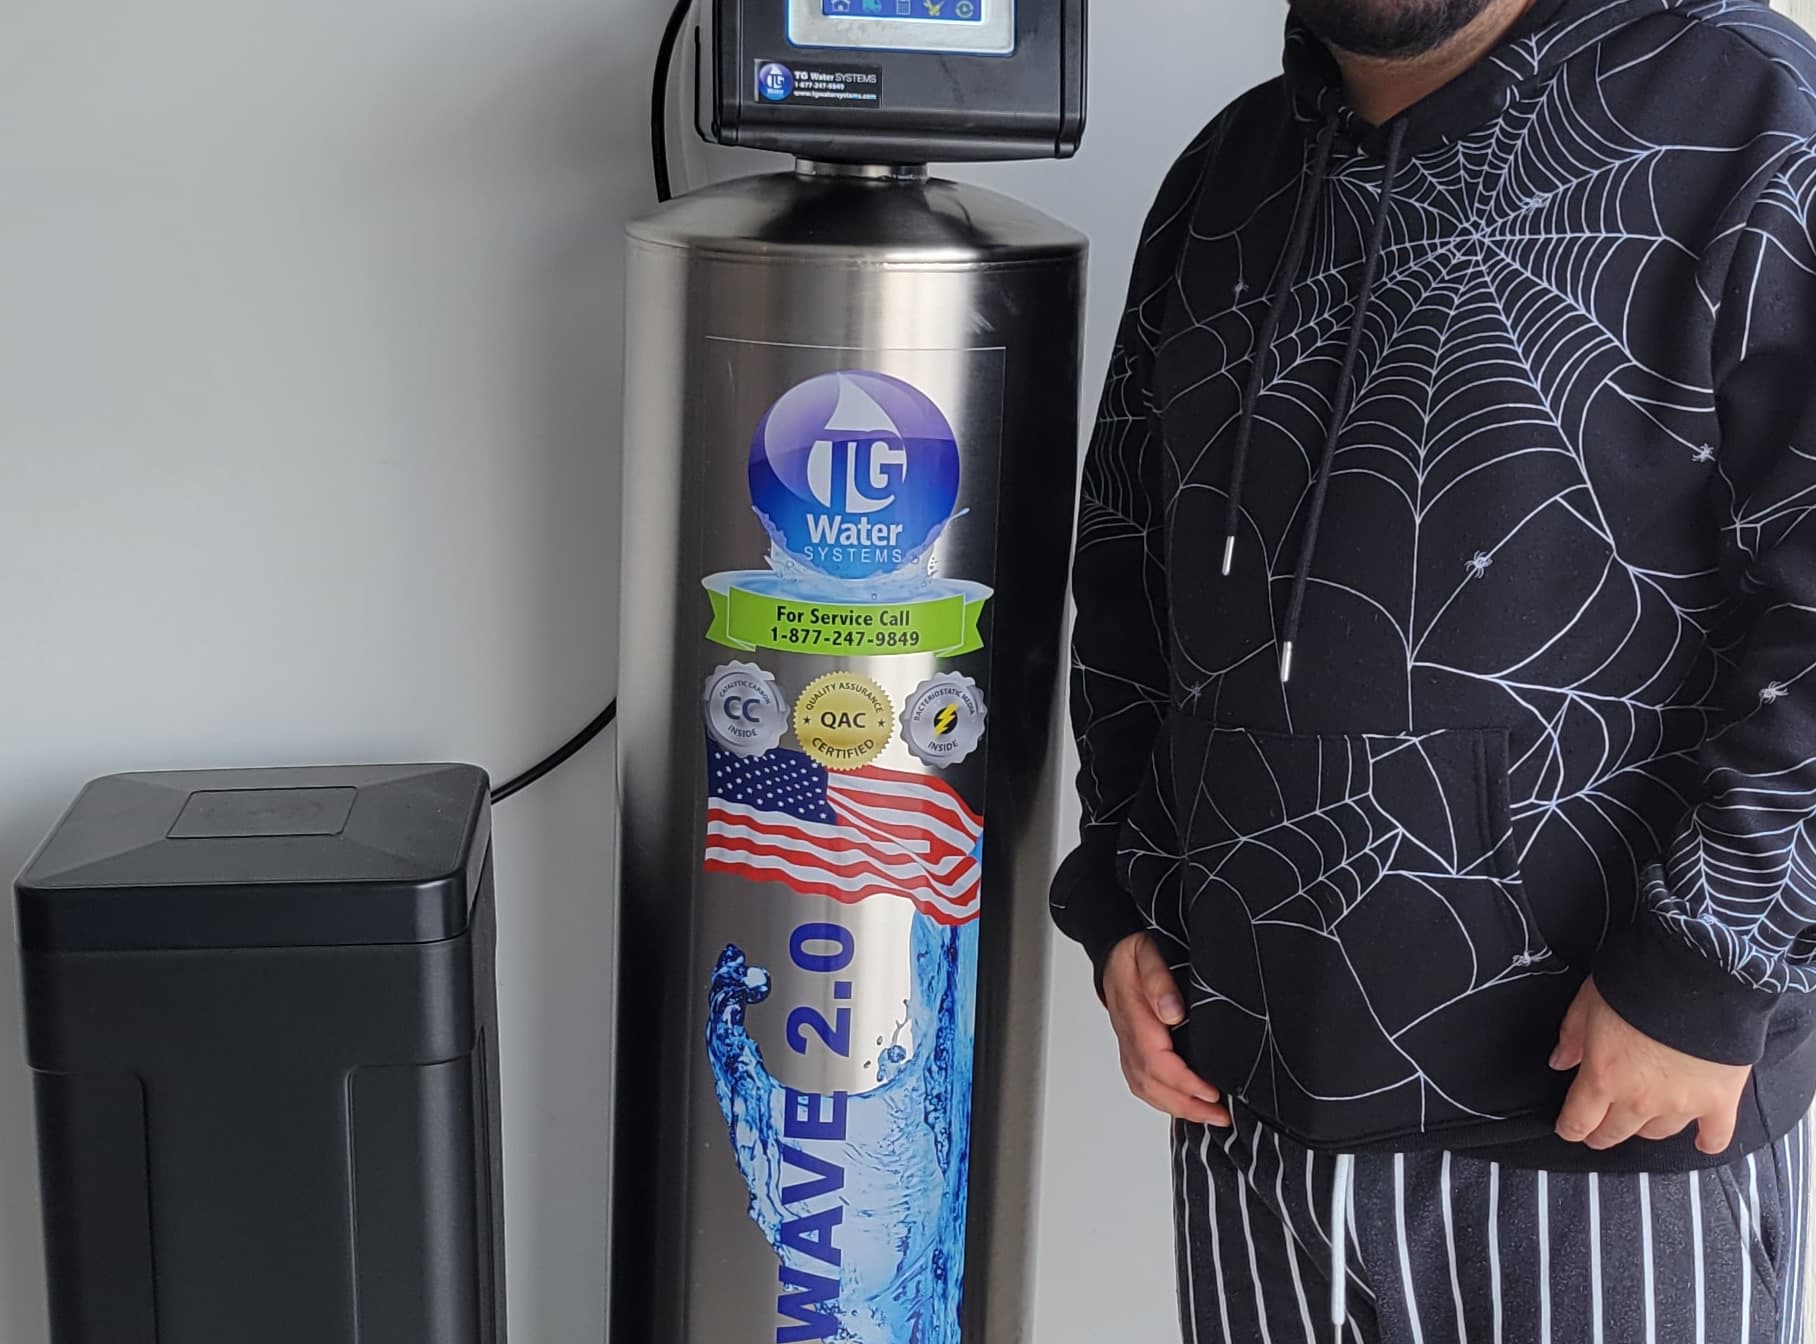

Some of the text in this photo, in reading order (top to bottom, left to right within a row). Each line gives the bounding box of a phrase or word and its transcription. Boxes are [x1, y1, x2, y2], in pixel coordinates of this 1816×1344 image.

[810, 71, 834, 81] Water
[835, 72, 877, 84] SYSTEMS
[806, 513, 903, 546] Water
[804, 546, 902, 563] SYSTEMS
[776, 606, 910, 627] For Service Call
[770, 627, 920, 647] 1-877-247-9849
[719, 680, 748, 698] CATALYTIC
[805, 682, 883, 713] QUALITY ASSURANCE
[723, 696, 761, 723] CC
[961, 694, 976, 715] MEDIA
[728, 724, 758, 738] INSIDE
[820, 711, 867, 730] QAC
[811, 737, 874, 759] CERTIFIED
[927, 740, 958, 752] INSIDE
[785, 921, 855, 1058] 2.0
[776, 1087, 848, 1344] WAVE
